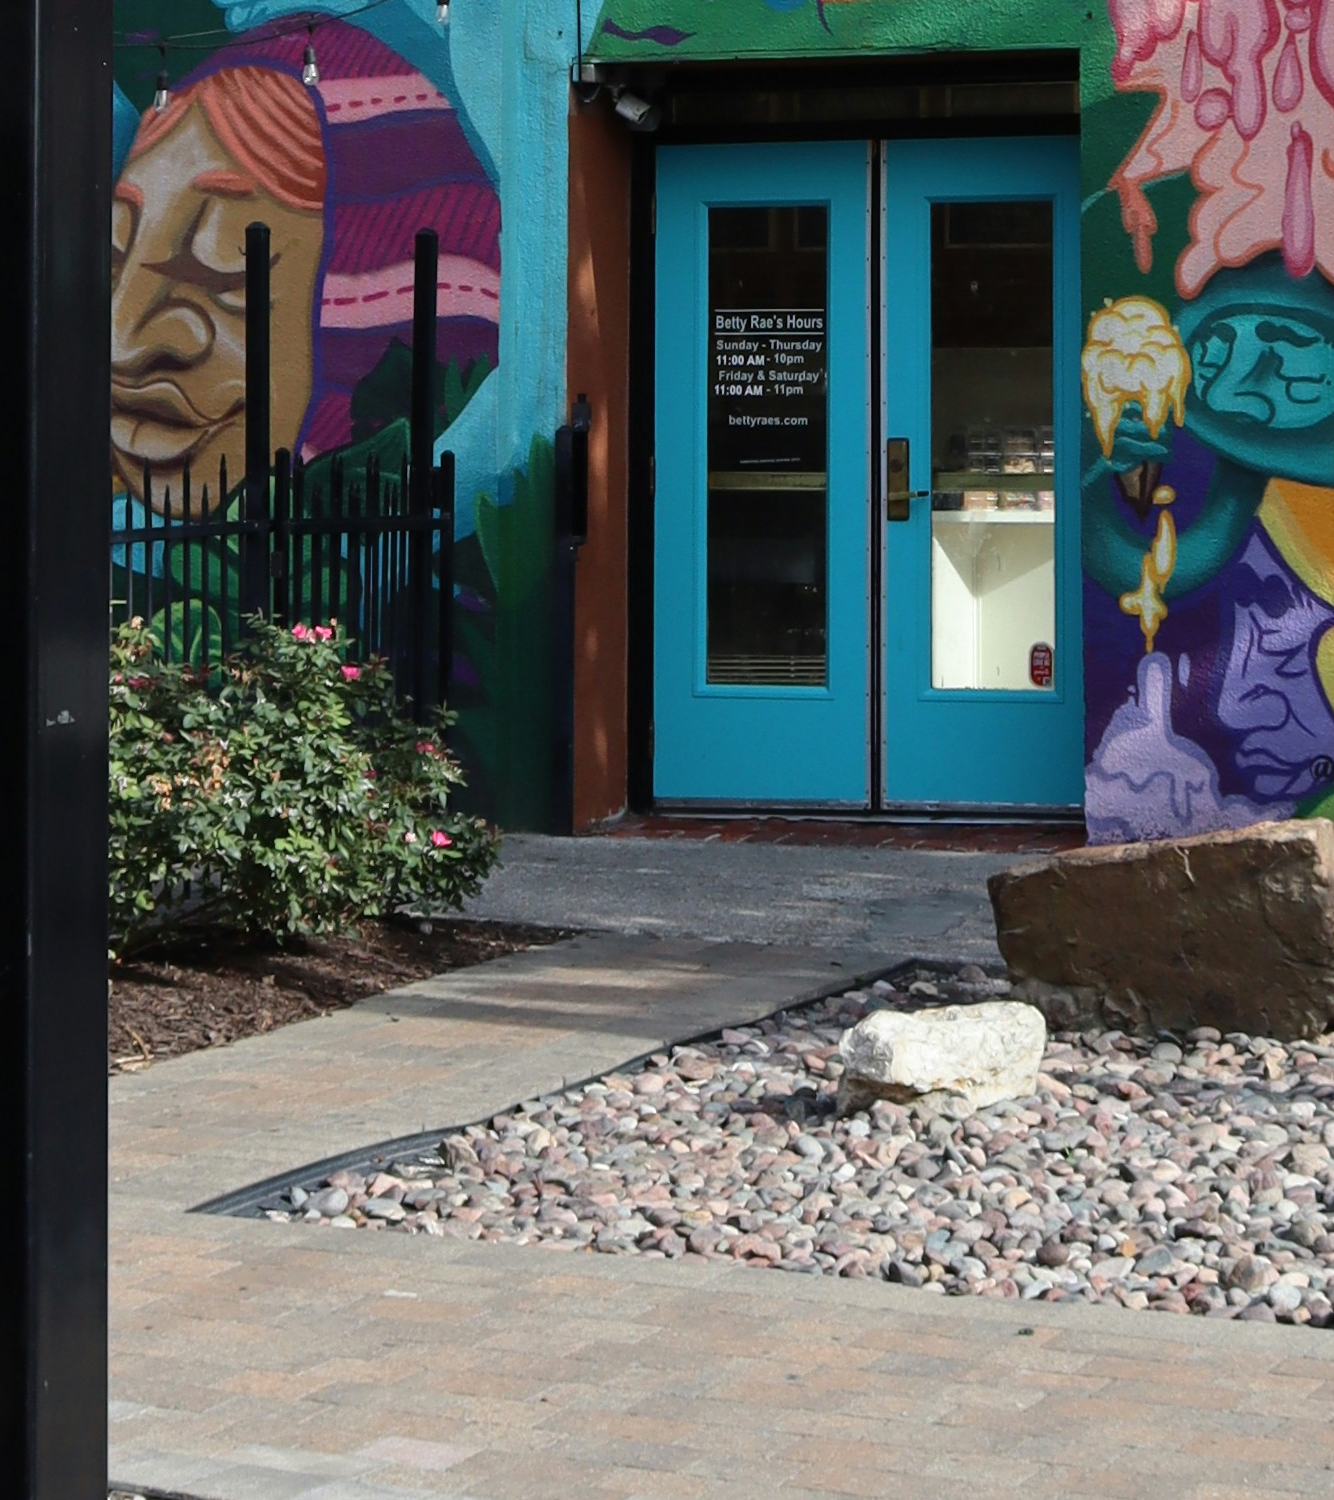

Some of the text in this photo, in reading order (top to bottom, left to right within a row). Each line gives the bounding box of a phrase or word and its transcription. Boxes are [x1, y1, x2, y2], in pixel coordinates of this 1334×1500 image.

[715, 314, 823, 333] Betty Rae's Hours
[716, 339, 759, 351] Sunday
[769, 338, 822, 352] Thursday
[716, 355, 744, 366] 11:00
[746, 355, 765, 366] AM
[774, 352, 804, 366] 10pm
[718, 370, 754, 383] Friday
[757, 370, 765, 380] &
[714, 385, 742, 396] 11:00
[744, 385, 763, 396] AM
[774, 383, 803, 396] 11pm
[728, 414, 808, 428] bettyraes.com
